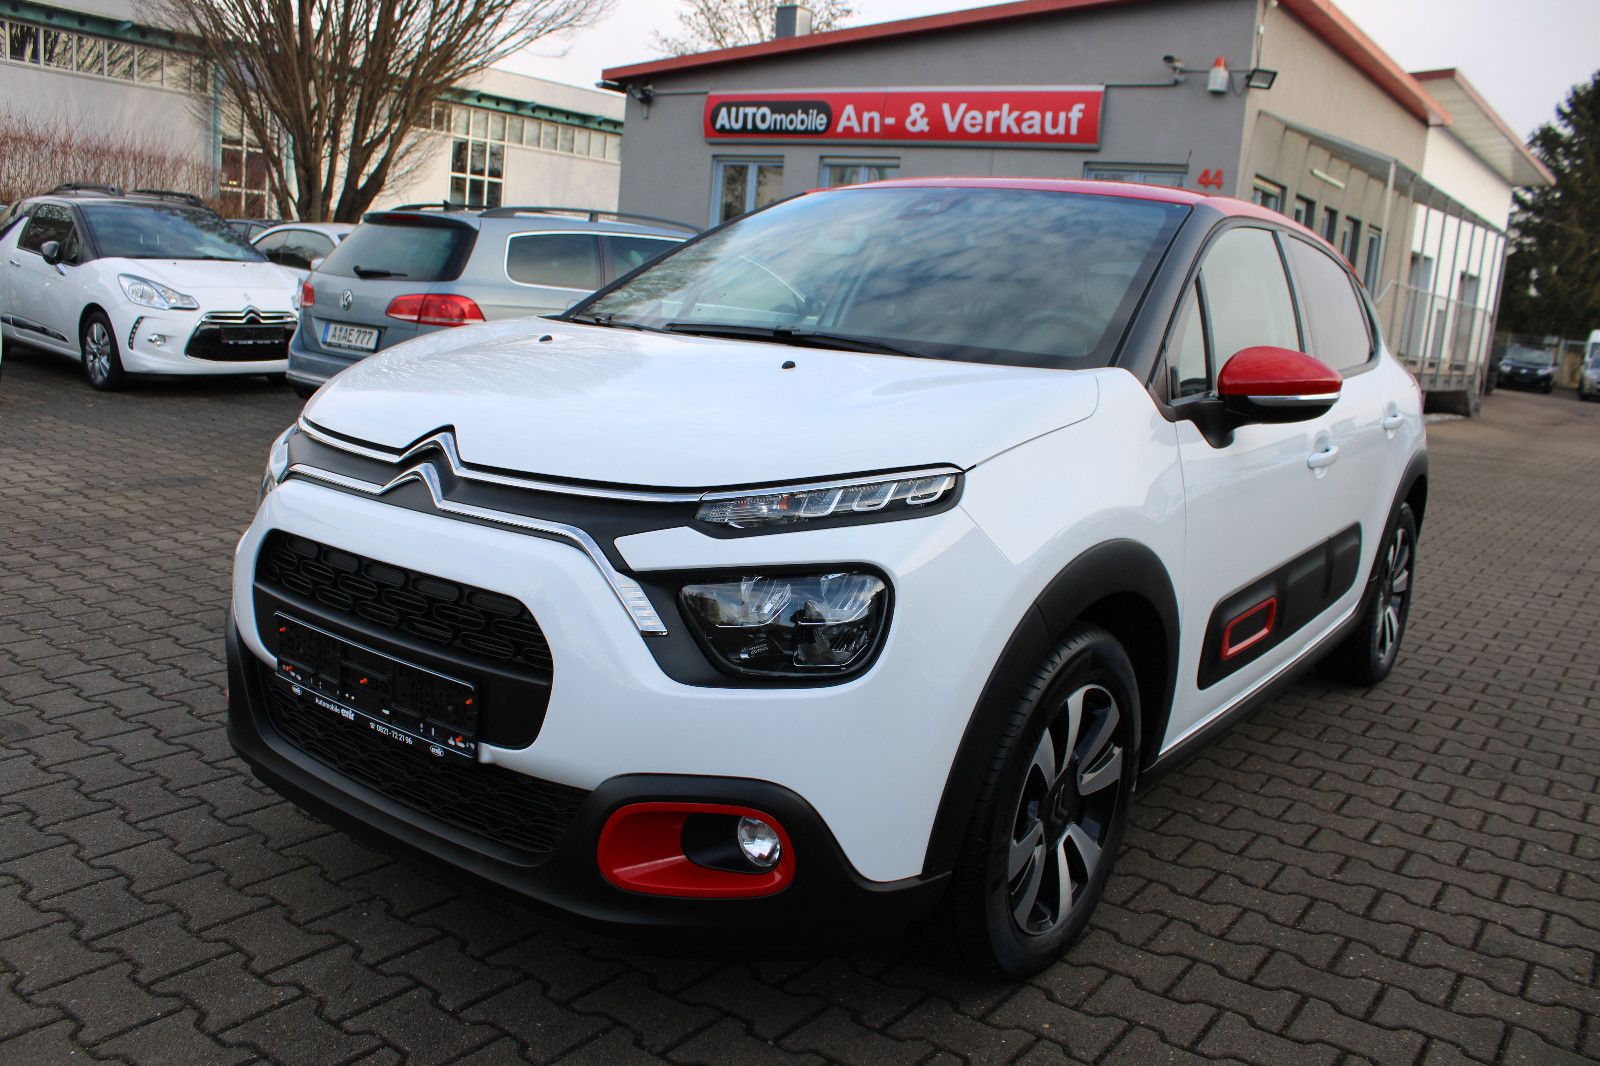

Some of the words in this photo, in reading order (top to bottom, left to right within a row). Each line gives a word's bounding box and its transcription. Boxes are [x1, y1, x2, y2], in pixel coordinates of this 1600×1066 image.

[715, 106, 828, 132] AUTOmobile
[836, 104, 896, 134] An-
[905, 102, 931, 133] &
[941, 103, 1086, 136] Verkauf
[1198, 168, 1224, 189] 44
[355, 330, 373, 346] 777
